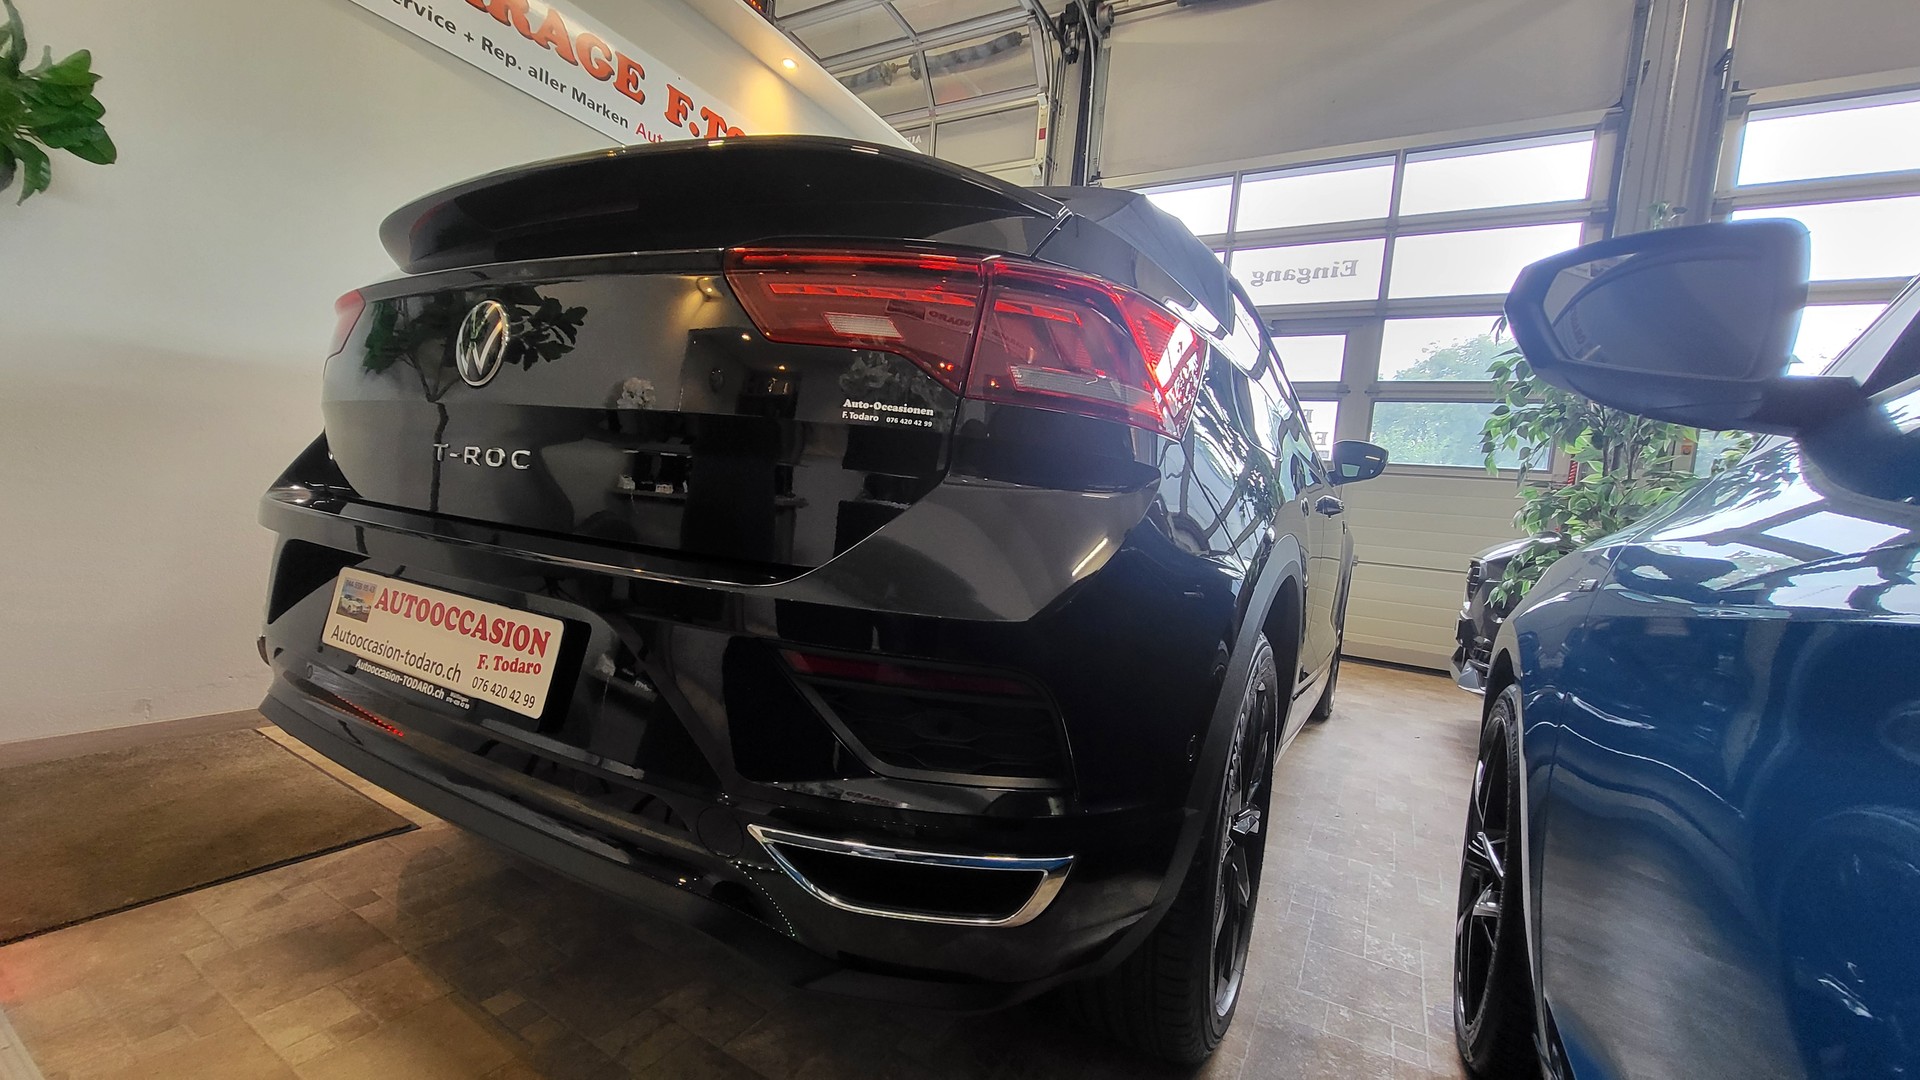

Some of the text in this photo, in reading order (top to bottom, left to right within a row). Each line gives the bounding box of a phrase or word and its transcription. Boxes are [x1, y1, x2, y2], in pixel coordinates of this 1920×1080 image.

[393, 0, 457, 35] rvice
[481, 36, 522, 71] Rep.
[528, 65, 567, 93] aller
[571, 86, 629, 129] Marken
[465, 0, 746, 138] RAGE F.T
[843, 398, 934, 416] Auto-Occasionen
[849, 412, 879, 422] Todaro
[433, 443, 531, 470] T-ROC
[374, 587, 551, 658] AUTOOCCASION
[331, 625, 461, 683] Autooccasion-todaro.ch
[477, 654, 542, 675] F. Todaro
[355, 659, 445, 700] Autooccasion-TODARO.ch
[472, 676, 536, 709] 076 420 42 99
